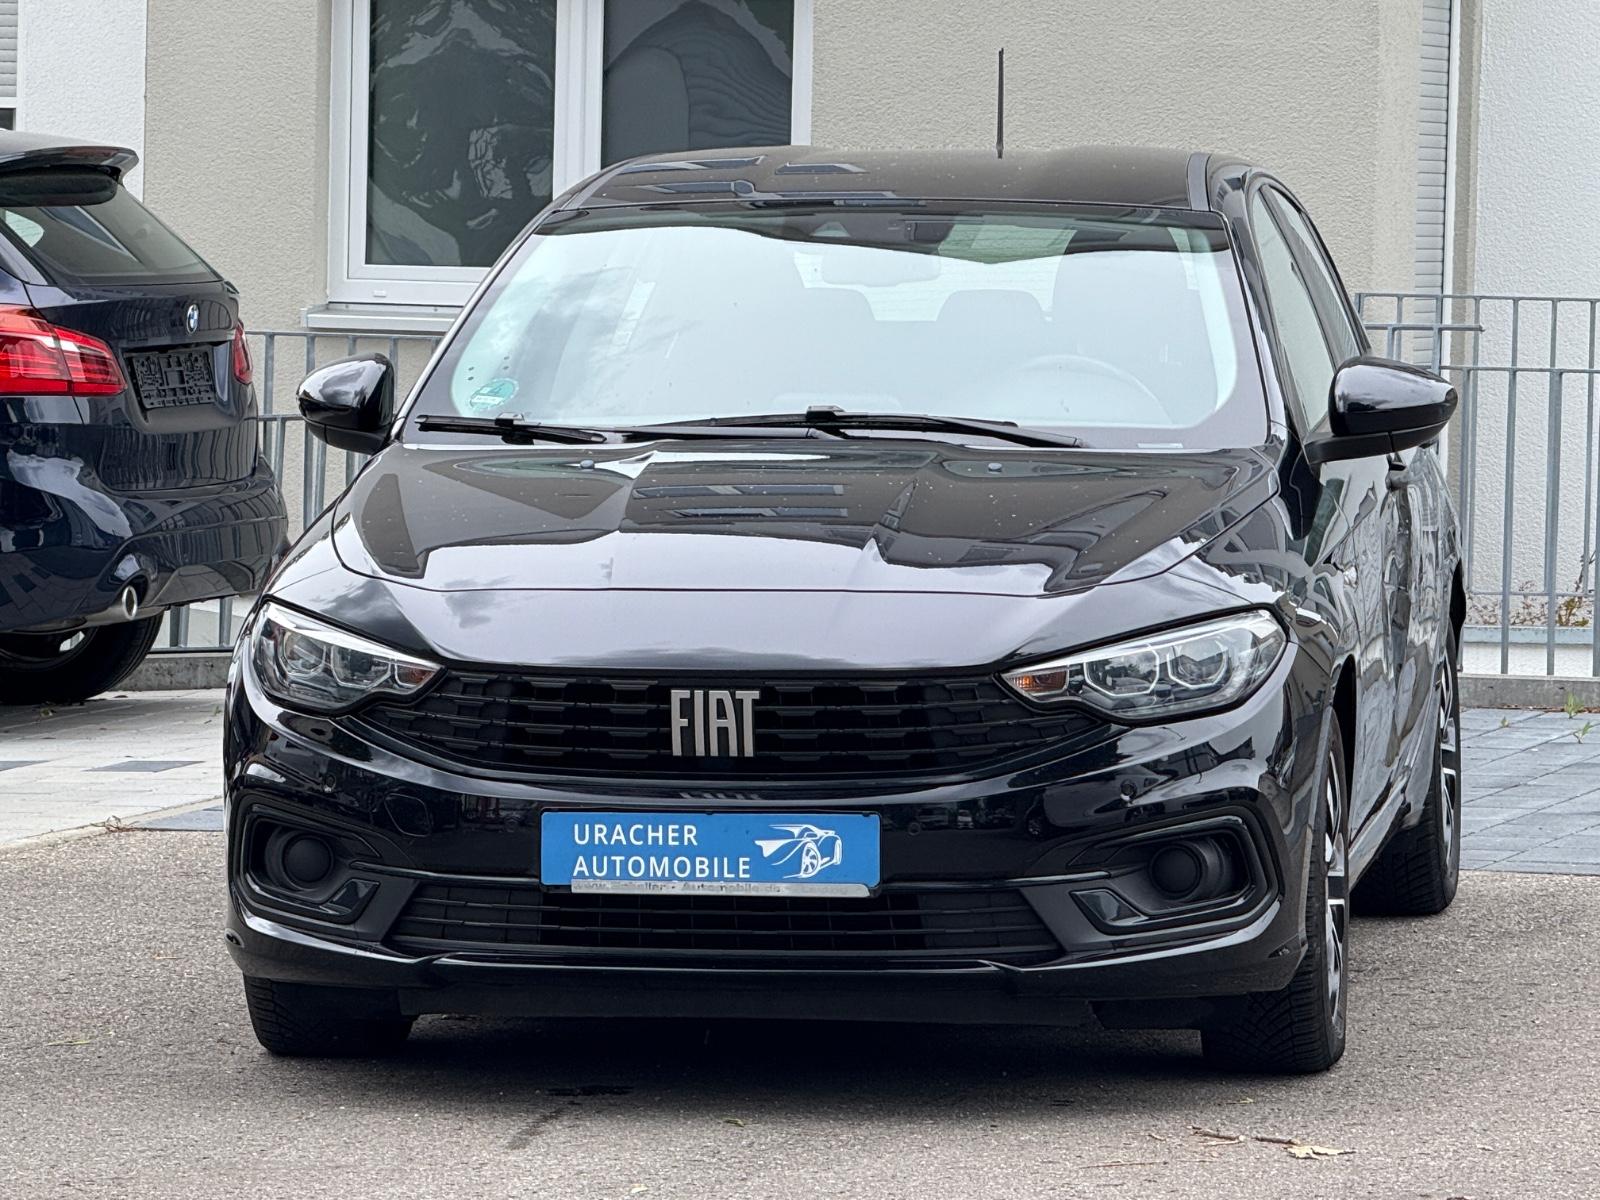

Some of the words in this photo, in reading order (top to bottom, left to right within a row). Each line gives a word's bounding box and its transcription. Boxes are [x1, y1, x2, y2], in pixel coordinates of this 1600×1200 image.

[671, 690, 760, 757] FIAT
[574, 824, 698, 846] URACHER
[573, 856, 750, 878] AUTOMOBILE
